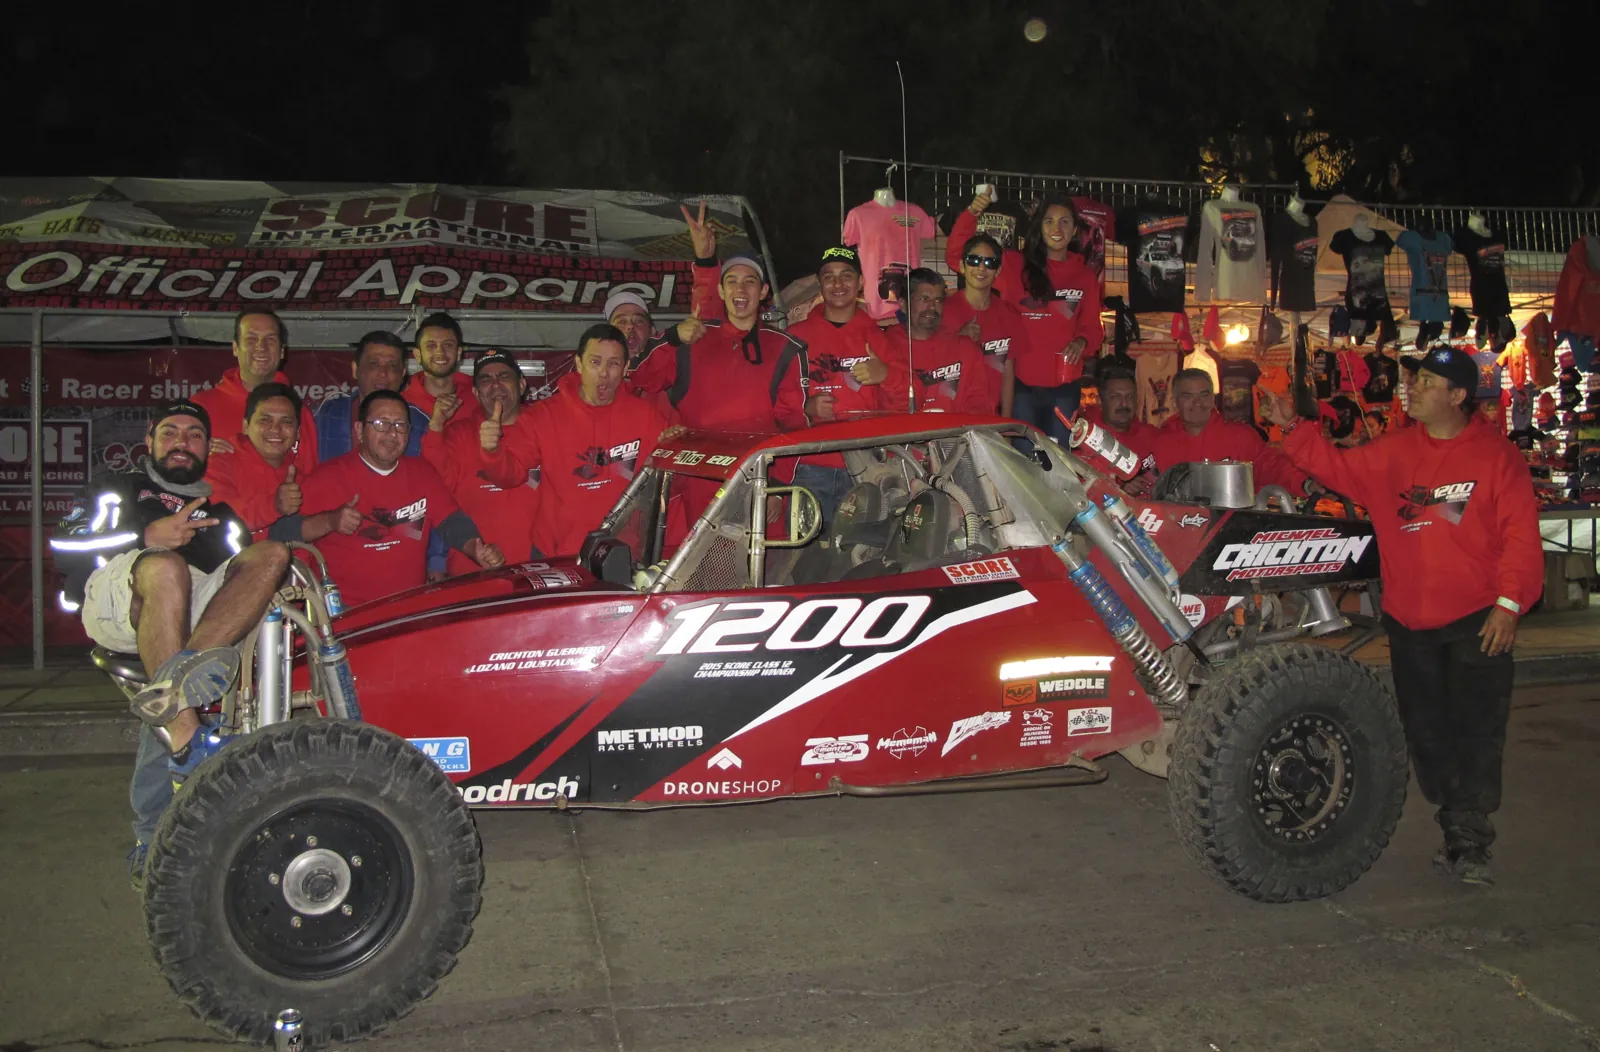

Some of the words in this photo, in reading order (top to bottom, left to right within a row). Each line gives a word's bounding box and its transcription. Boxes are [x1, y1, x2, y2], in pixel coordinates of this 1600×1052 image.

[262, 194, 592, 245] SCORE
[7, 252, 324, 299] Official
[338, 258, 674, 308] Apparel
[932, 362, 961, 379] 1200
[62, 379, 142, 400] Racer
[609, 440, 641, 458] 1200
[1434, 482, 1475, 499] 1200
[396, 497, 427, 520] 1200
[1250, 528, 1342, 545] MICHAEL
[1213, 535, 1372, 571] CRICHTON
[945, 558, 1013, 578] SCORE
[1226, 561, 1346, 583] MOTORSPORTS
[655, 595, 932, 656] 1200
[488, 650, 544, 662] CRICHTON
[545, 645, 605, 657] GUERRERO
[469, 661, 516, 674] LOZANO
[693, 669, 761, 678] CHAMPIONSHIP
[760, 668, 797, 676] WINNER
[699, 663, 724, 671] 2015
[722, 662, 753, 670] SCORE
[751, 661, 781, 669] CLASS
[781, 660, 793, 668] 12
[1039, 678, 1105, 693] WEDDLE
[598, 725, 704, 745] METHOD
[598, 743, 636, 752] RACE
[643, 738, 704, 750] WHEELS
[801, 734, 870, 766] 25
[664, 779, 782, 795] DRONESHOP
